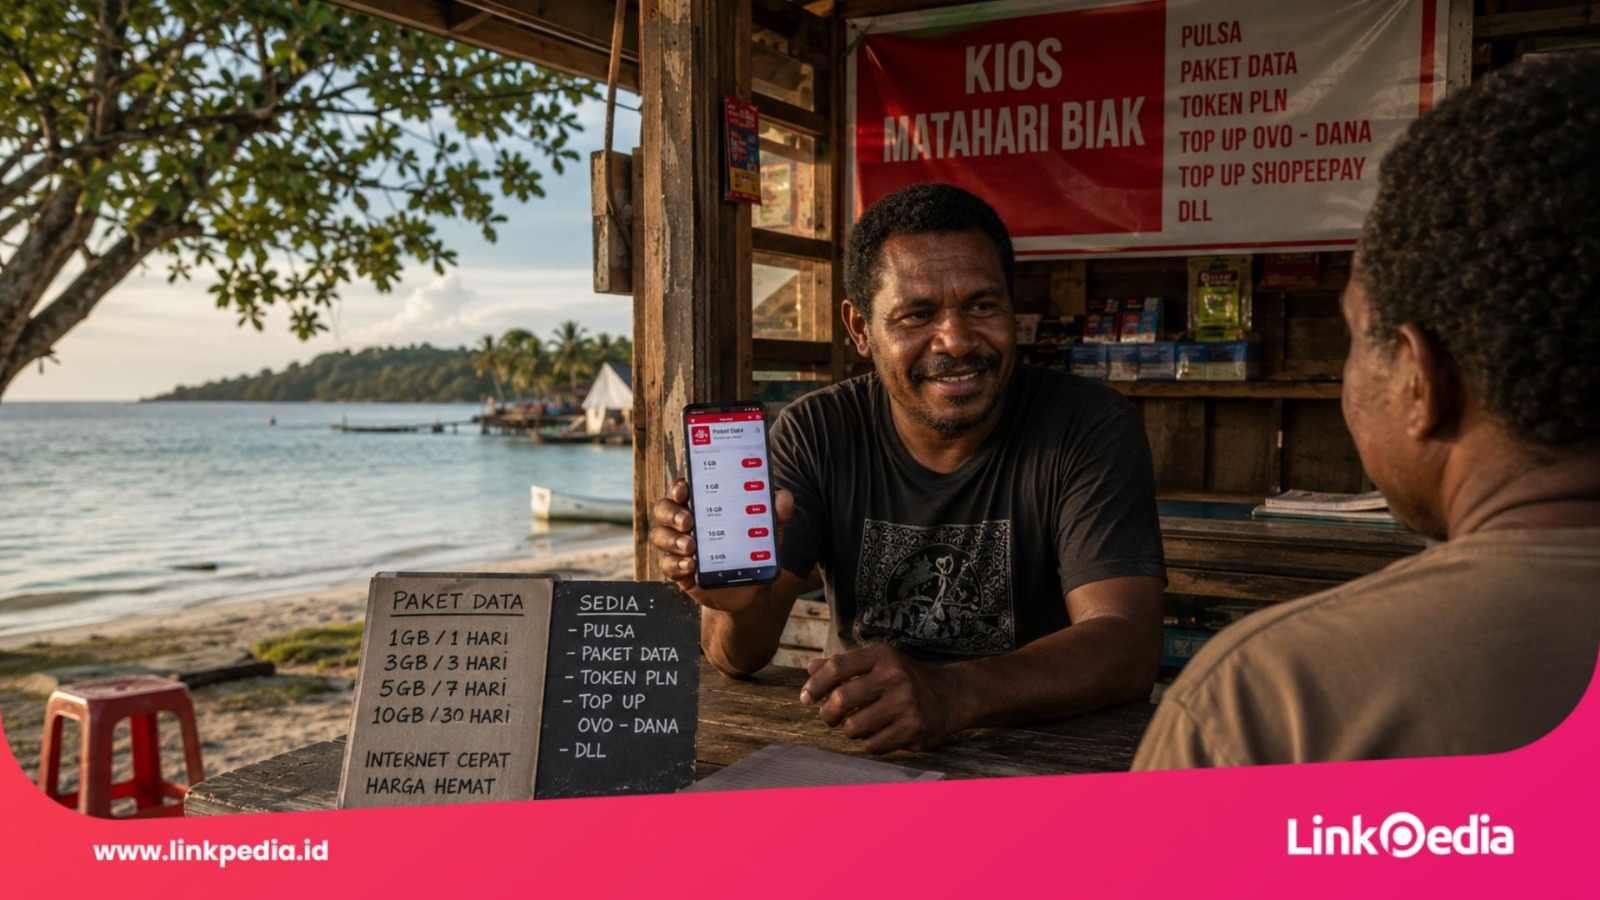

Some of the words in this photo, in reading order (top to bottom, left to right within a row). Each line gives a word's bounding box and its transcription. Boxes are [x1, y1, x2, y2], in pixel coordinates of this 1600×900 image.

[1182, 20, 1242, 48] PULSA
[965, 37, 1063, 94] KIOS
[1180, 56, 1241, 83] PAKET
[1249, 51, 1298, 78] DATA
[1180, 92, 1243, 118] TOKEN
[1250, 88, 1288, 114] PLN
[883, 104, 1048, 163] MATAHARI
[1062, 96, 1145, 150] BIAK
[1180, 130, 1215, 153] TOP
[1222, 128, 1246, 151] UP
[1253, 125, 1293, 149] OVO
[1316, 120, 1372, 146] DANA
[1179, 165, 1214, 188] TOP
[1221, 164, 1245, 186] UP
[1252, 157, 1366, 184] SHOPEEPAY
[1179, 200, 1213, 222] DLL
[392, 591, 463, 610] PAKET
[473, 593, 524, 610] DATA
[580, 595, 639, 611] SEDIA
[389, 629, 430, 646] 1GB
[450, 630, 458, 646] 1
[584, 623, 635, 638] PULSA
[384, 654, 428, 671] 3GB
[447, 656, 459, 670] 3
[582, 646, 633, 661] PAKET
[640, 647, 679, 662] DATA
[580, 670, 636, 685] TOKEN
[646, 670, 678, 686] PLN
[380, 680, 426, 697] 5GB
[446, 681, 458, 696] 7
[579, 693, 613, 709] TOP
[622, 693, 646, 709] UP
[372, 706, 424, 724] 10GB
[441, 707, 464, 723] 30
[578, 717, 613, 733] OVO
[634, 718, 679, 733] DANA
[575, 742, 606, 758] DLL
[365, 751, 450, 768] INTERNET
[457, 752, 511, 768] CEPAT
[366, 777, 425, 794] HARGA
[435, 778, 496, 794] HEMAT
